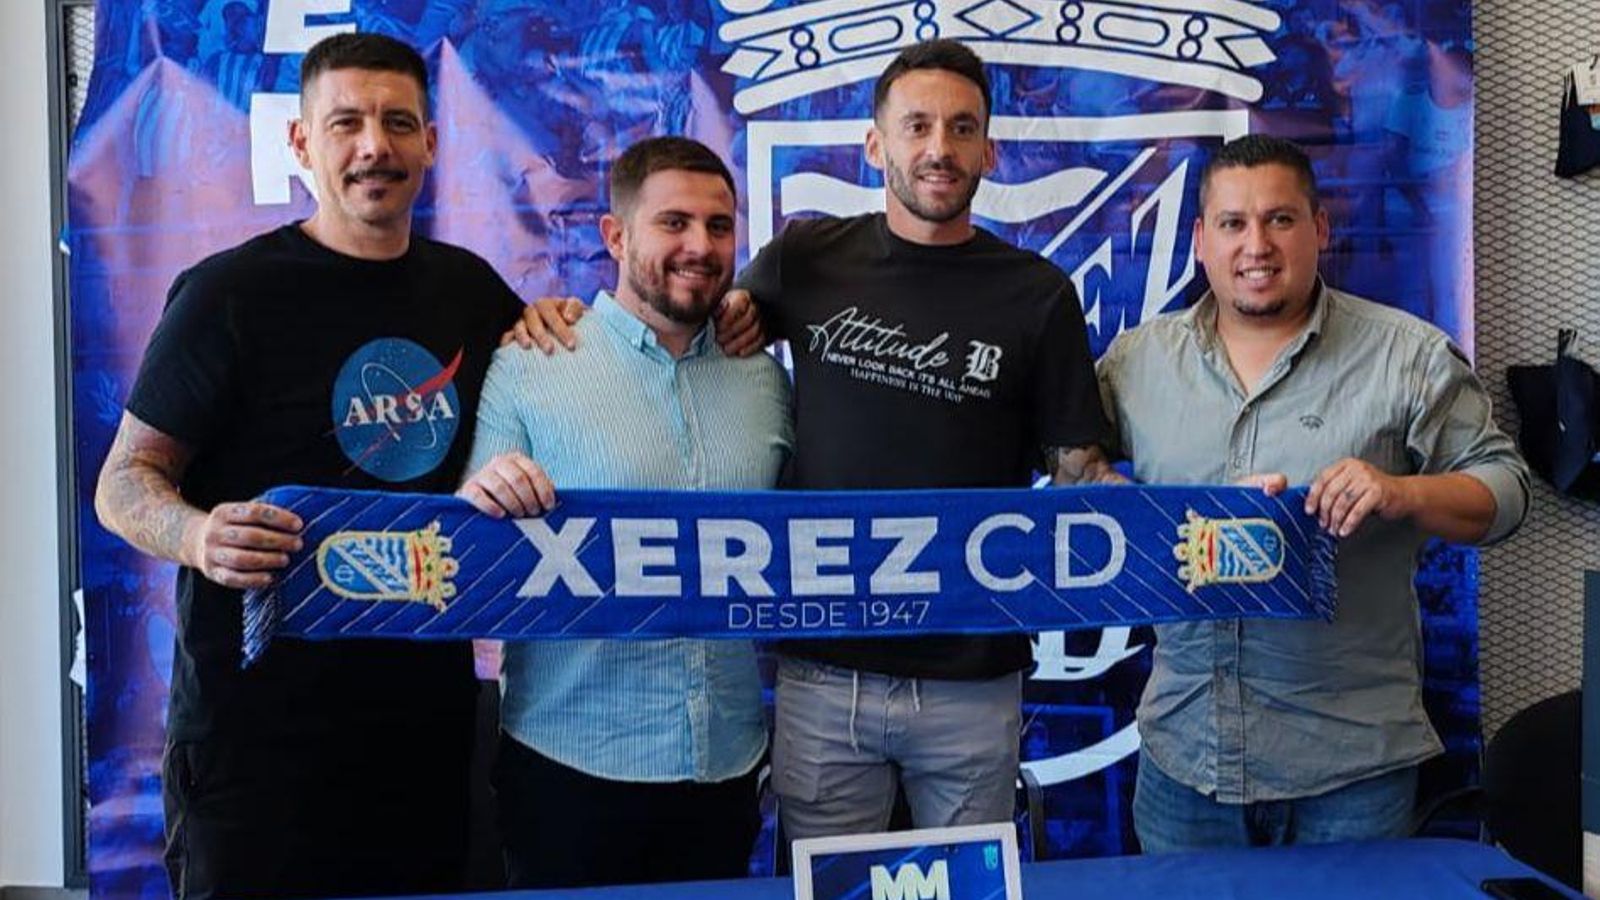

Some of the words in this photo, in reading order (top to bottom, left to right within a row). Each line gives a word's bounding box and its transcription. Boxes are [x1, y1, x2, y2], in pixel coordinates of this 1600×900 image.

[806, 306, 949, 370] Attitude
[964, 339, 1002, 382] B
[826, 352, 856, 366] NEVER
[858, 358, 886, 373] LOOK
[888, 365, 915, 380] BACK
[938, 377, 955, 390] ALL
[343, 390, 455, 427] ARSA
[512, 515, 940, 597] XEREZ
[965, 512, 1127, 593] CD
[728, 602, 847, 629] DESDE
[858, 600, 931, 627] 1947
